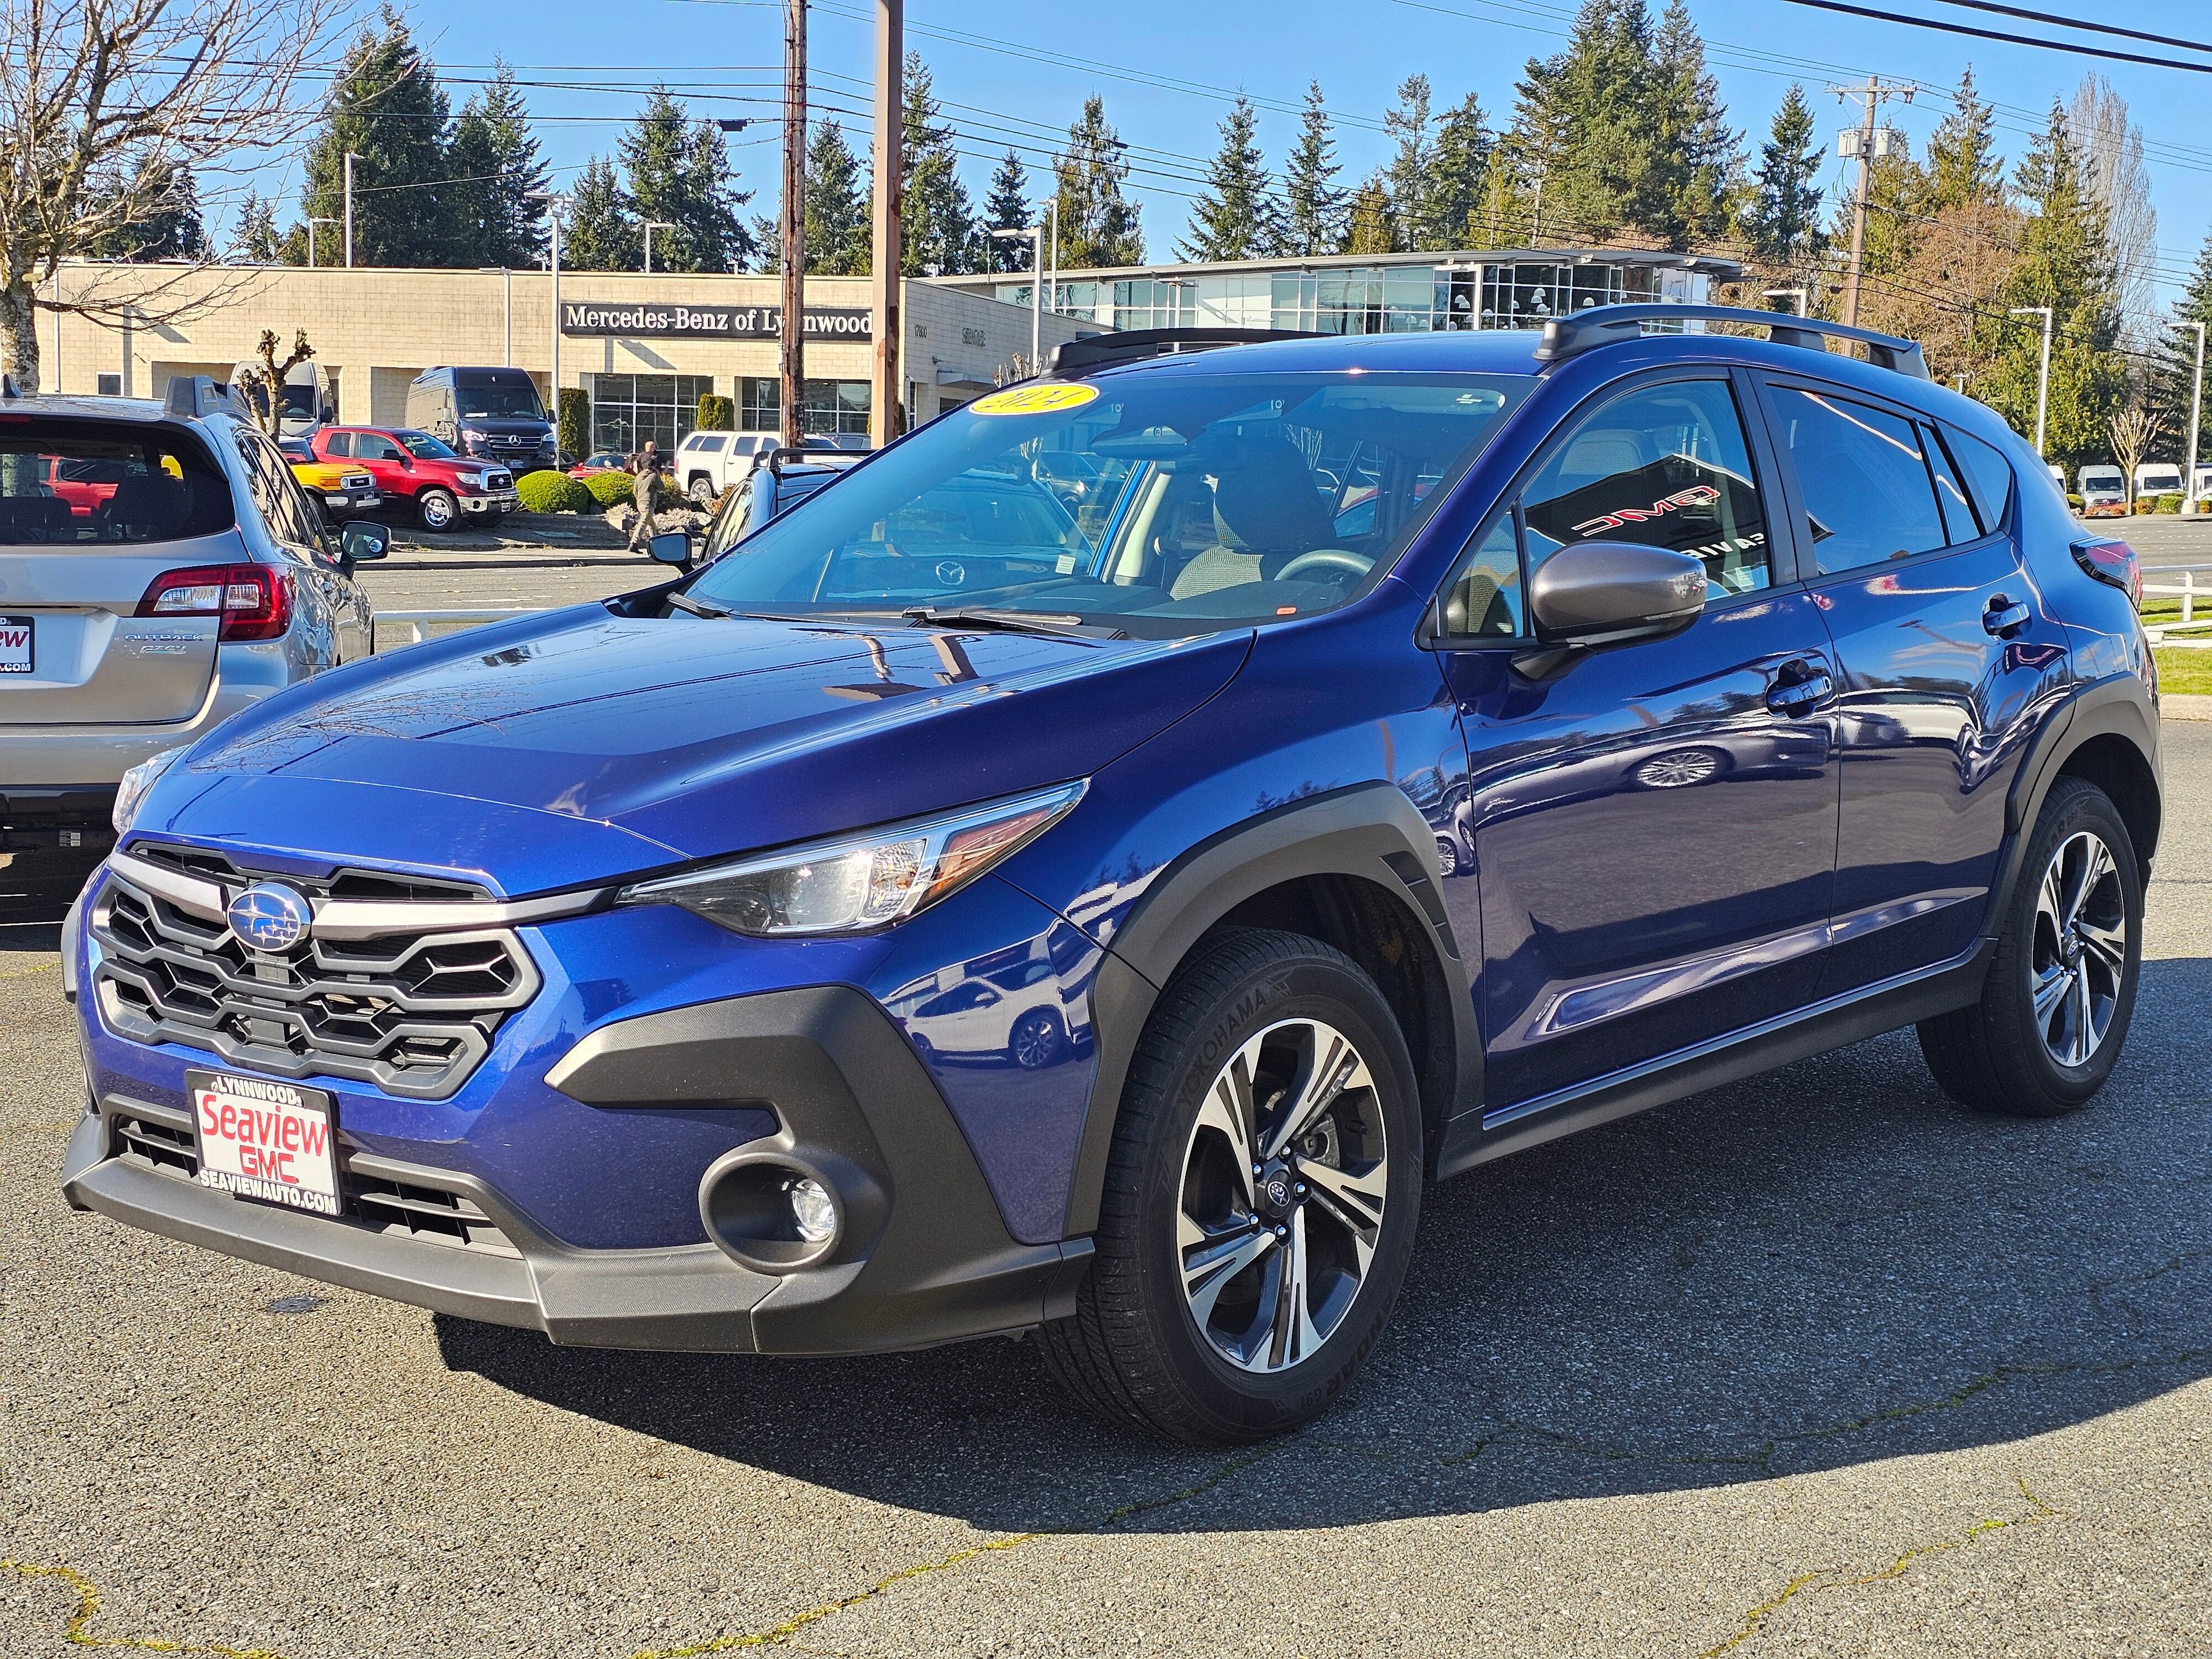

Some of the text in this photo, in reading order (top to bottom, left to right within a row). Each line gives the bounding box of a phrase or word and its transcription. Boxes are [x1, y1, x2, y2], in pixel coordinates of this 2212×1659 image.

[566, 305, 873, 337] Mercedes-Benz of Lynwood
[1176, 988, 1268, 1107] YOKOHAMA
[216, 1076, 298, 1106] LYNNWOOD
[202, 1094, 327, 1157] Seaview
[239, 1145, 299, 1184] GMC
[200, 1168, 338, 1215] SEAVIEWAUTO.COM
